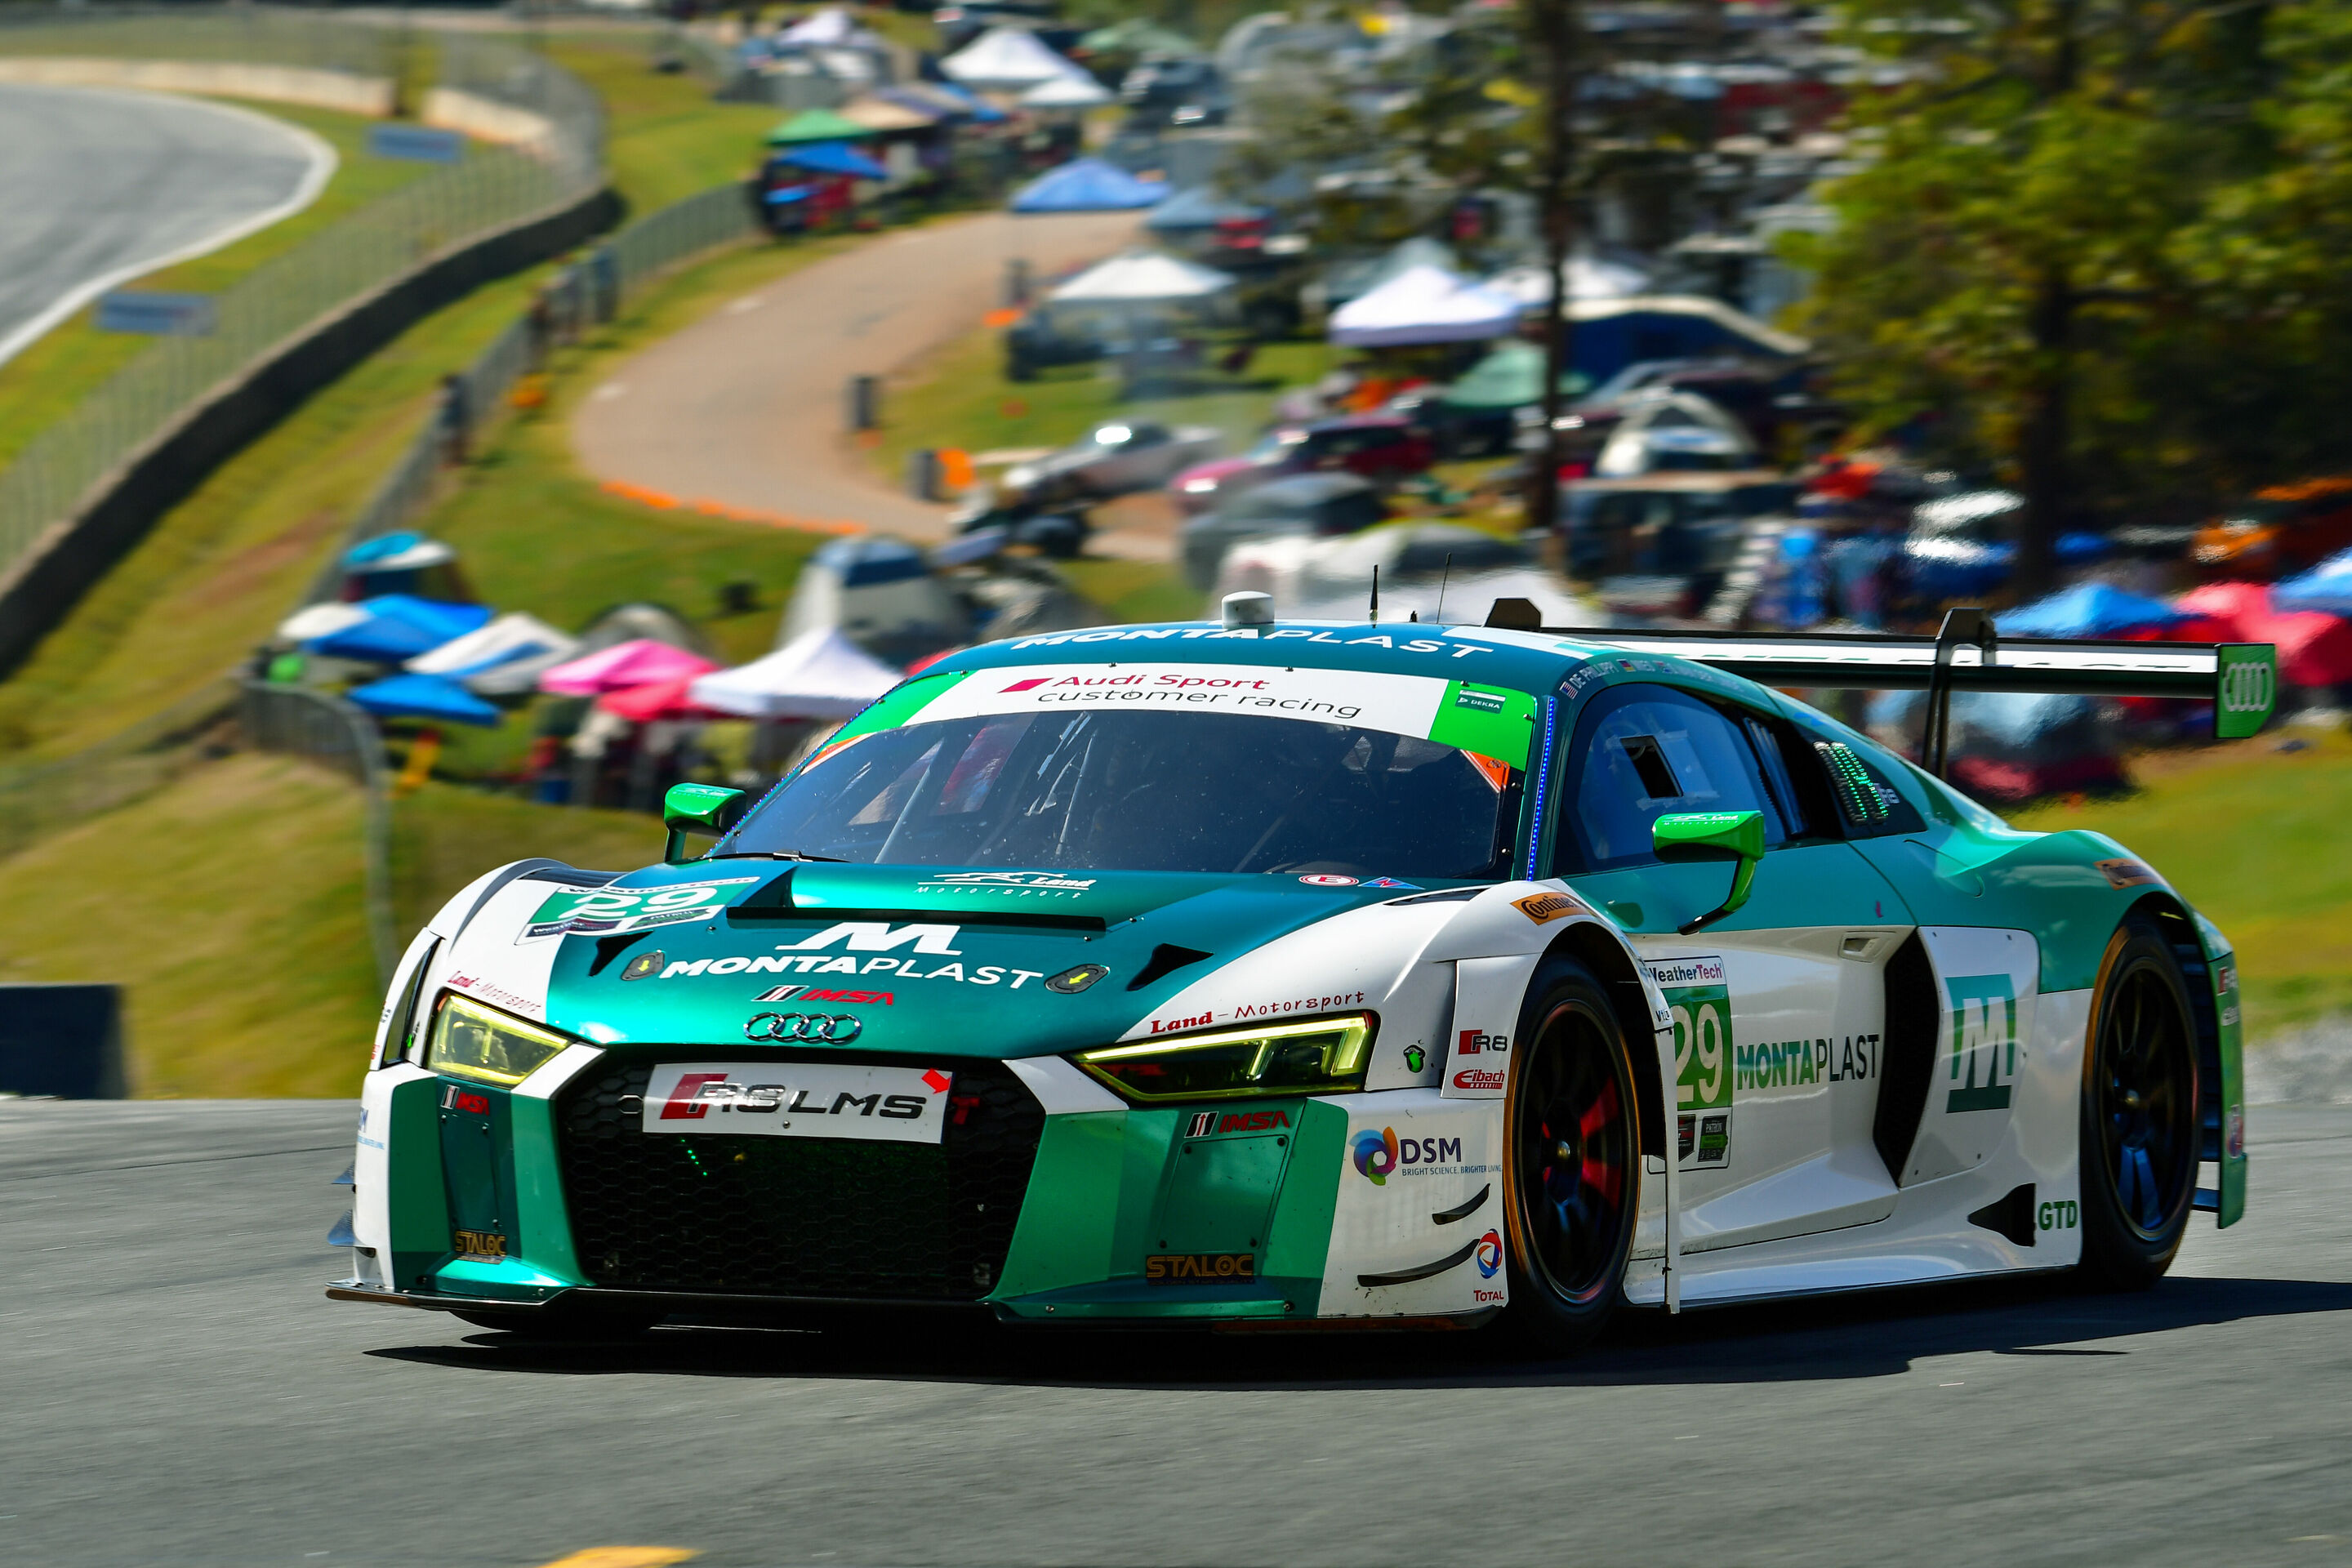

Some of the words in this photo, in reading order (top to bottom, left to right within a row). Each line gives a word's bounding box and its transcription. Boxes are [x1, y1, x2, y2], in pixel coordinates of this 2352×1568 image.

[1010, 627, 1494, 659] MONTAPLAST
[1051, 674, 1146, 688] Audi
[1152, 674, 1271, 690] Sport
[1037, 689, 1228, 704] customer
[1235, 695, 1362, 719] racing
[1471, 699, 1500, 710] DEKRA
[913, 885, 1082, 899] Motorsport
[1029, 876, 1097, 887] Land
[558, 886, 718, 920] 29
[775, 922, 963, 956] M
[658, 956, 1045, 991] MONTAPLAST
[799, 989, 894, 1006] IMSA
[1150, 1011, 1214, 1035] Land
[1234, 990, 1366, 1021] Motorsport
[1471, 1035, 1508, 1052] R8
[1676, 1003, 1722, 1104] 29
[1736, 1034, 1879, 1090] MONTAPLAST
[1453, 1069, 1505, 1089] Eibach
[1218, 1111, 1290, 1133] IMSA
[1400, 1138, 1462, 1164] DSM
[1402, 1168, 1429, 1176] BRIGHT
[1430, 1166, 1459, 1174] SCIENCE.
[1460, 1165, 1486, 1174] BRIGHTER
[2038, 1200, 2078, 1230] GTD
[455, 1231, 506, 1257] STALOC
[1147, 1254, 1254, 1277] STALOC
